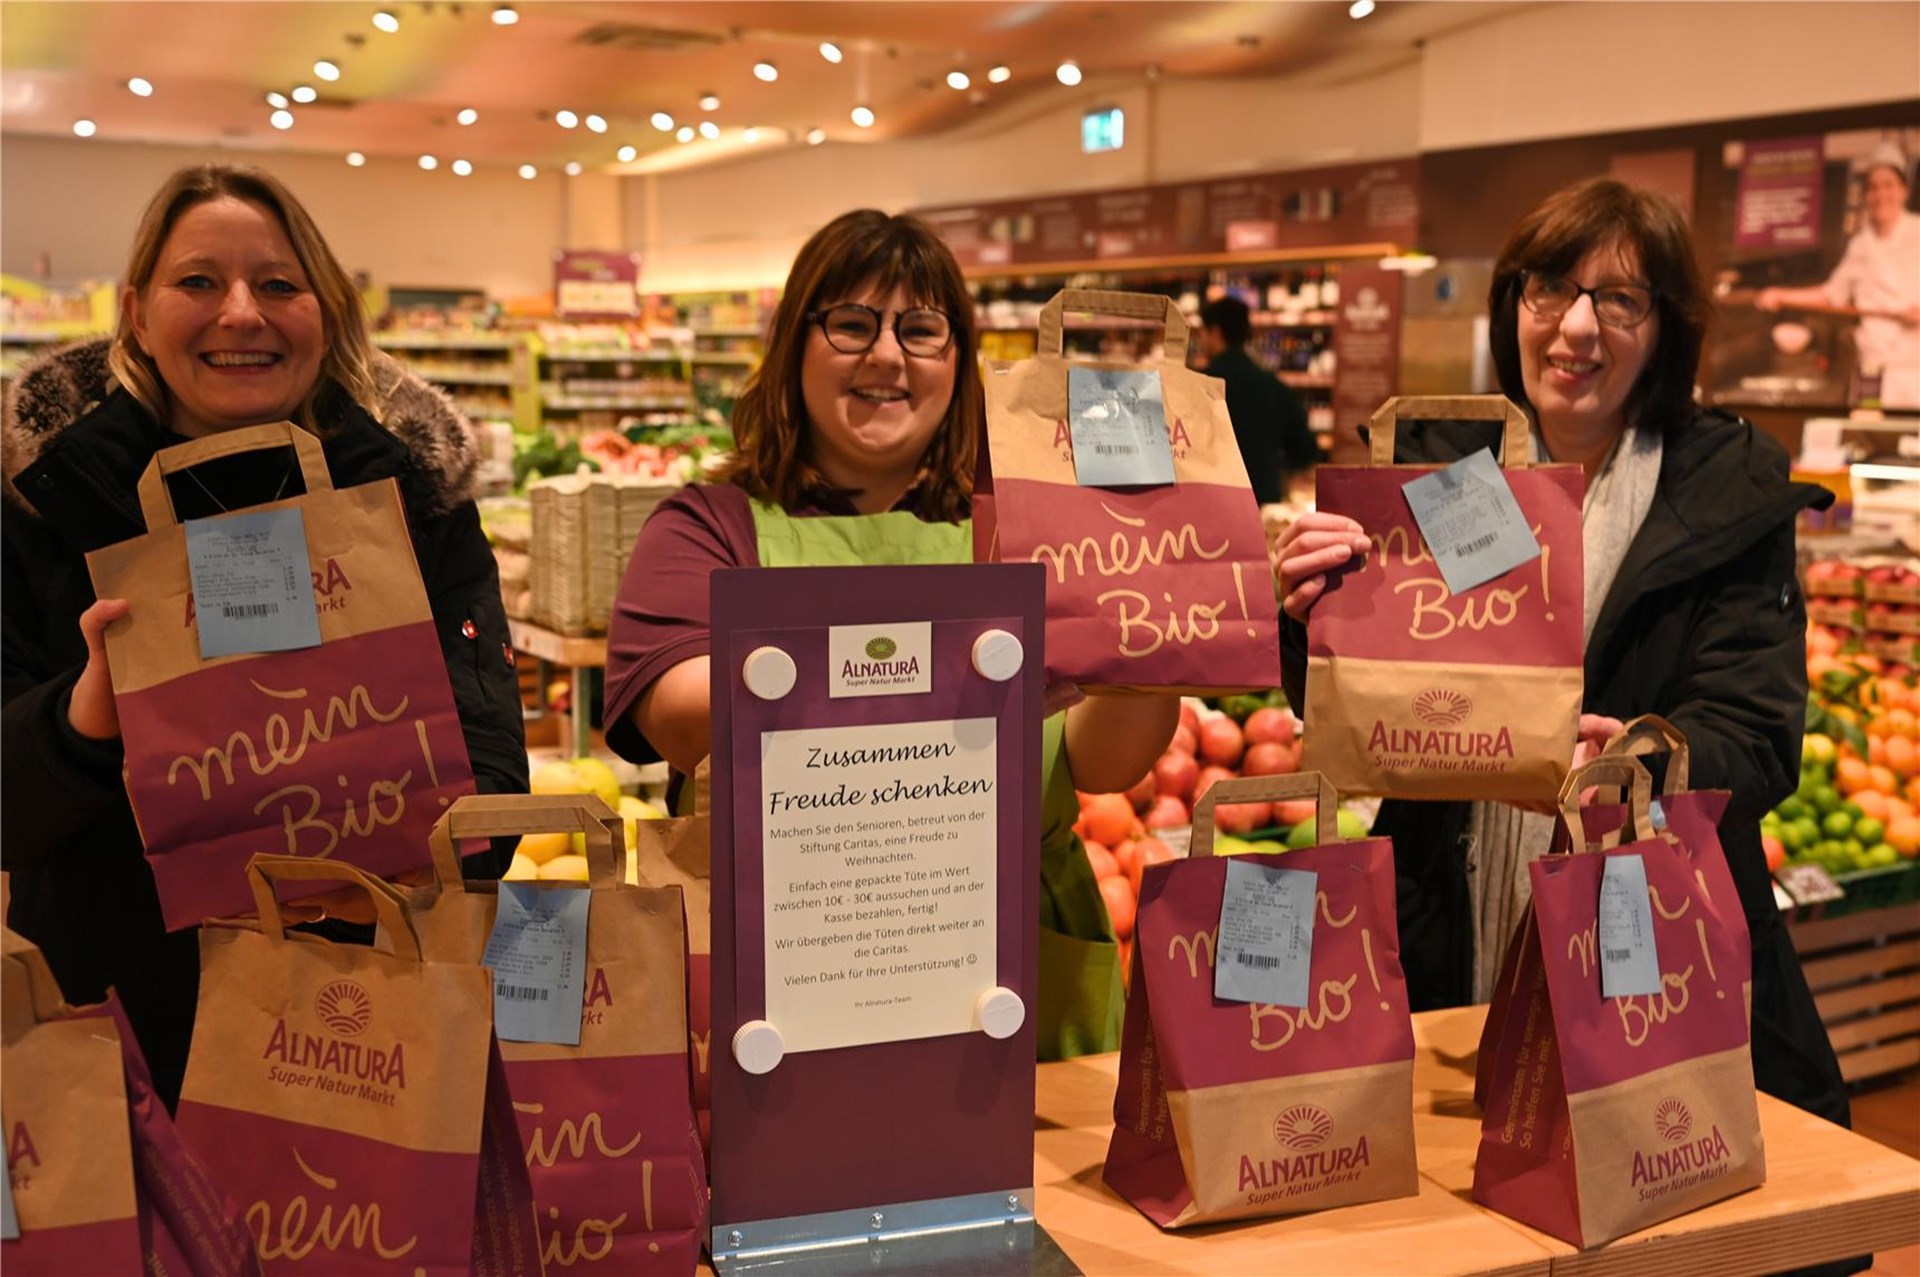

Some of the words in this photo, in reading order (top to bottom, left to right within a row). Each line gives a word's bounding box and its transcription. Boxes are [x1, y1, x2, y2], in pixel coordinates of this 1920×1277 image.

[841, 655, 920, 679] ALNATURA
[845, 678, 868, 688] Super
[869, 676, 891, 686] Natur
[892, 675, 916, 685] Markt
[1367, 719, 1515, 759] ALNATURA
[805, 741, 957, 769] Zusammen
[1374, 755, 1415, 770] Super
[1417, 757, 1459, 771] Natur
[1461, 759, 1506, 773] Markt
[768, 783, 868, 816] Freude
[869, 774, 994, 806] schenken
[770, 826, 814, 840] Machen
[815, 824, 832, 835] Sie
[833, 823, 854, 834] den
[856, 819, 905, 832] Senioren,
[907, 814, 945, 827] betreut
[947, 813, 966, 823] von
[968, 810, 985, 821] der
[799, 841, 842, 854] Stiftung
[843, 838, 882, 850] Caritas,
[884, 835, 907, 847] eine
[908, 830, 945, 843] Freude
[946, 831, 959, 840] zu
[844, 851, 917, 867] Weihnachten.
[789, 880, 828, 893] Einfach
[830, 878, 853, 889] eine
[854, 873, 902, 889] gepackte
[904, 871, 927, 881] Tüte
[929, 869, 942, 879] im
[944, 866, 970, 878] Wert
[773, 898, 822, 912] zwischen
[825, 895, 844, 907] 10€
[854, 892, 873, 904] 30€
[875, 887, 929, 902] aussuchen
[931, 884, 951, 895] und
[953, 884, 966, 893] an
[968, 880, 985, 892] der
[824, 912, 853, 924] Kasse
[855, 907, 905, 921] bezahlen,
[907, 902, 939, 915] fertig!
[775, 938, 794, 950] Wir
[797, 933, 853, 947] übergeben
[855, 930, 872, 941] die
[874, 928, 904, 939] Tüten
[906, 924, 936, 936] direkt
[938, 920, 969, 932] weiter
[972, 918, 985, 928] an
[853, 948, 870, 958] die
[784, 974, 817, 987] Vielen
[819, 970, 846, 983] Dank
[848, 968, 864, 980] für
[866, 967, 887, 977] Ihre
[889, 956, 964, 975] Unterstützung!
[262, 1018, 406, 1090] ALNATURA
[267, 1065, 313, 1088] Super
[314, 1074, 357, 1097] Natur
[358, 1084, 396, 1108] Markt
[1531, 1063, 1546, 1087] Sie
[1501, 1068, 1526, 1144] Gemeinsam
[1516, 1047, 1530, 1066] für
[1522, 1088, 1541, 1135] helfen
[1519, 1131, 1533, 1149] So
[1238, 1134, 1370, 1193] ALNATURA
[1631, 1124, 1731, 1188] ALNATURA
[1246, 1189, 1284, 1206] Super
[1285, 1180, 1321, 1197] Natur
[1322, 1170, 1361, 1188] Markt
[1638, 1183, 1670, 1202] Super
[1670, 1173, 1699, 1191] Natur
[1699, 1162, 1728, 1183] Markt
[541, 1159, 660, 1266] io!
